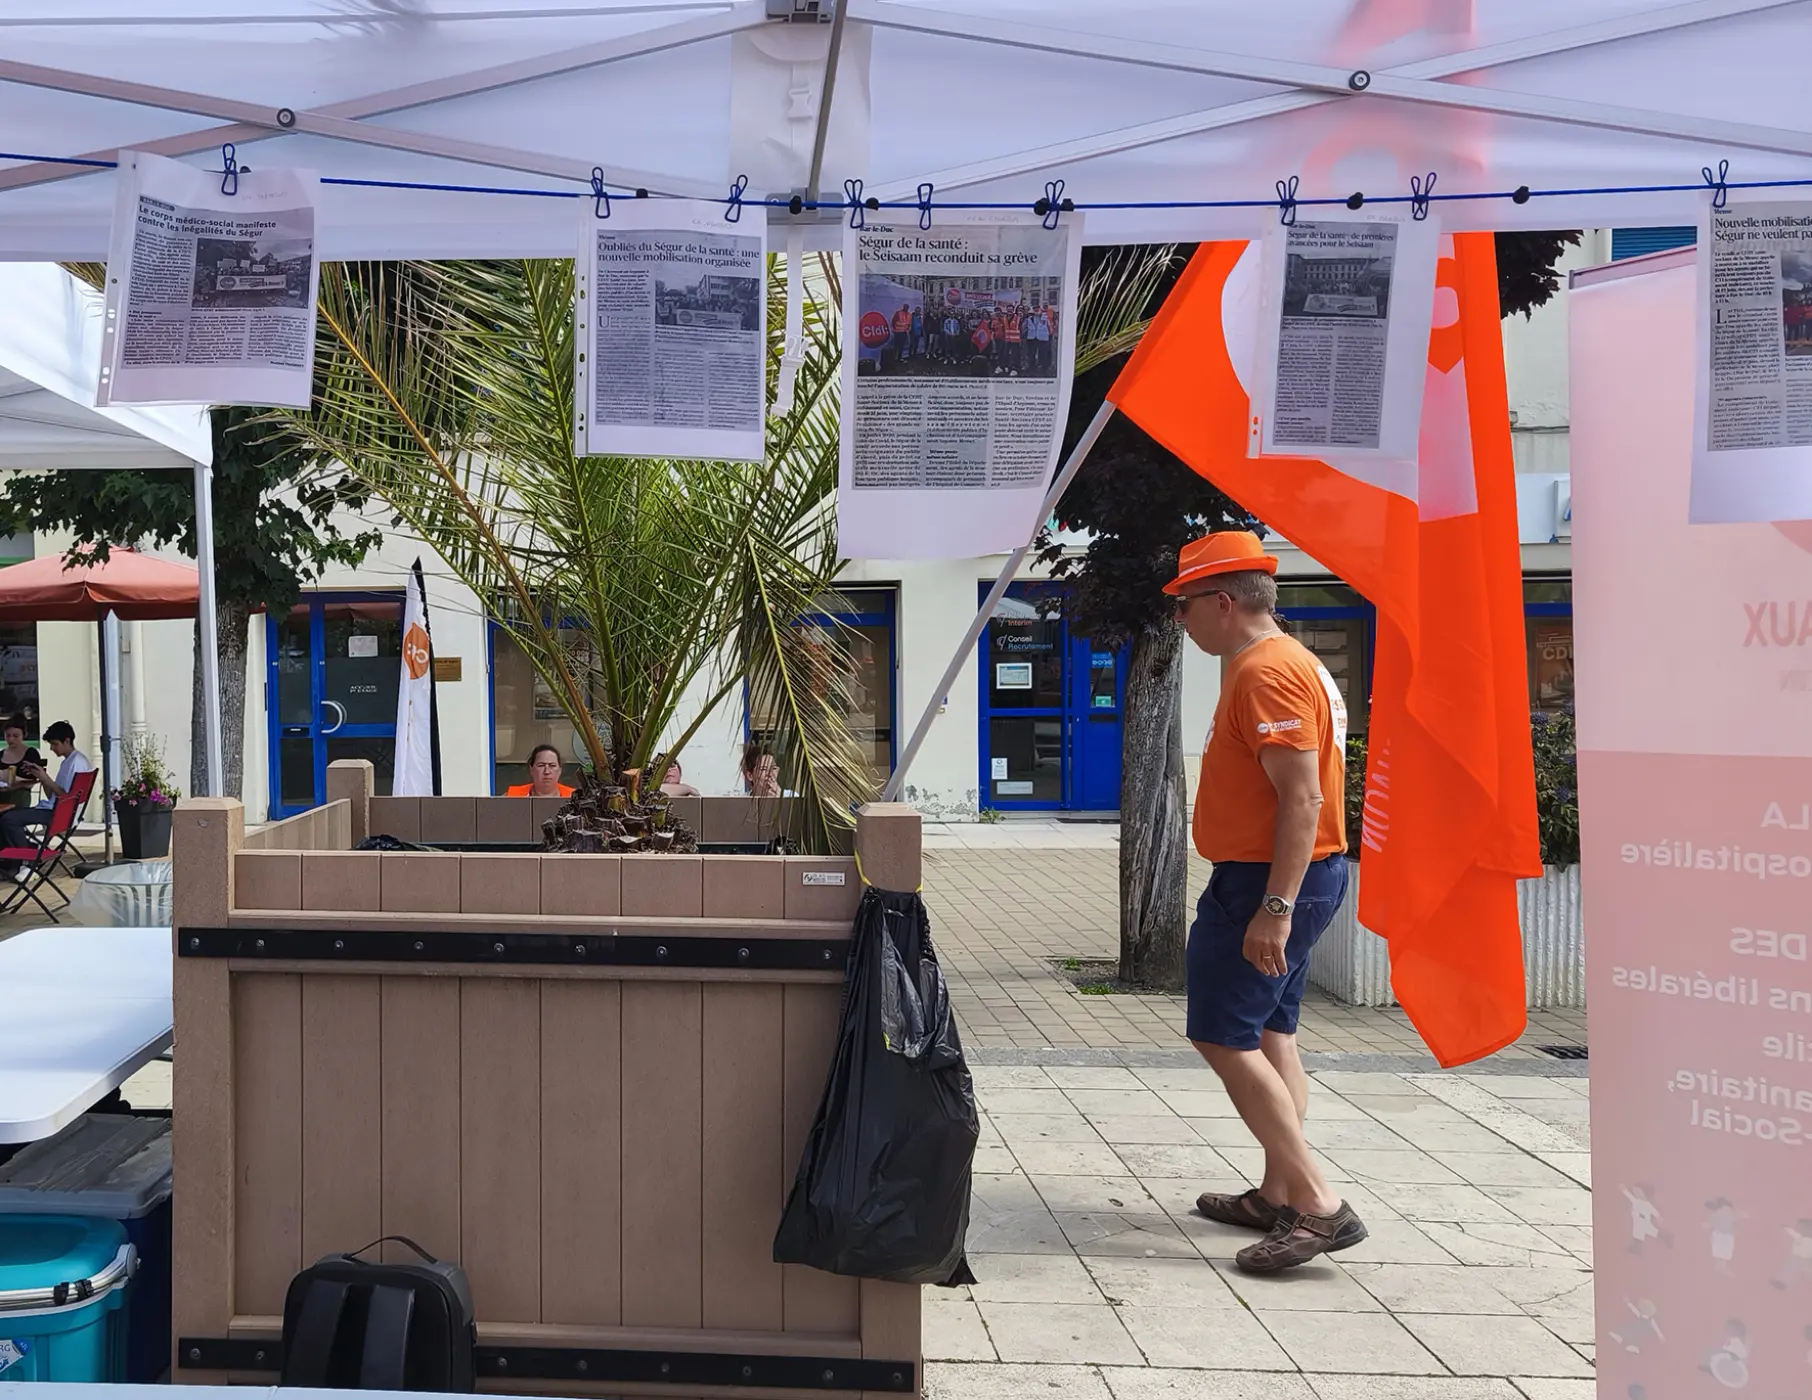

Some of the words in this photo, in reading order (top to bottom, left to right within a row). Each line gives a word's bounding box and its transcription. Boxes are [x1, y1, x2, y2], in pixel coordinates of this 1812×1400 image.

[139, 204, 149, 215] Le
[150, 210, 173, 224] corps
[175, 216, 234, 228] médico-social
[236, 220, 277, 229] manifeste
[1715, 217, 1760, 229] Nouvelle
[138, 215, 165, 229] contre
[167, 220, 179, 232] les
[181, 224, 223, 236] inégalités
[226, 227, 236, 236] du
[238, 228, 263, 238] Ségur
[859, 235, 894, 251] Ségur
[897, 236, 912, 249] de
[915, 237, 926, 249] la
[929, 237, 962, 250] santé
[1310, 231, 1319, 240] de
[1320, 231, 1326, 240] la
[1351, 232, 1360, 240] de
[1361, 232, 1394, 242] premières
[1715, 230, 1745, 243] Ségur
[1747, 231, 1760, 240] ne
[1762, 228, 1799, 240] veulent
[598, 241, 636, 252] Oubliés
[638, 242, 652, 252] du
[654, 241, 682, 255] Ségur
[685, 243, 697, 254] de
[699, 244, 707, 255] la
[708, 245, 735, 257] santé
[741, 251, 760, 259] une
[1320, 240, 1337, 249] pour
[1338, 239, 1346, 248] le
[598, 252, 641, 262] nouvelle
[643, 252, 703, 264] mobilisation
[705, 258, 751, 269] organisée
[859, 249, 871, 261] le
[873, 249, 922, 263] Seisaam
[925, 251, 984, 264] reconduit
[987, 254, 1001, 264] sa
[1003, 252, 1038, 267] grève
[1008, 635, 1033, 643] Conseil
[1008, 643, 1053, 651] Recrutement
